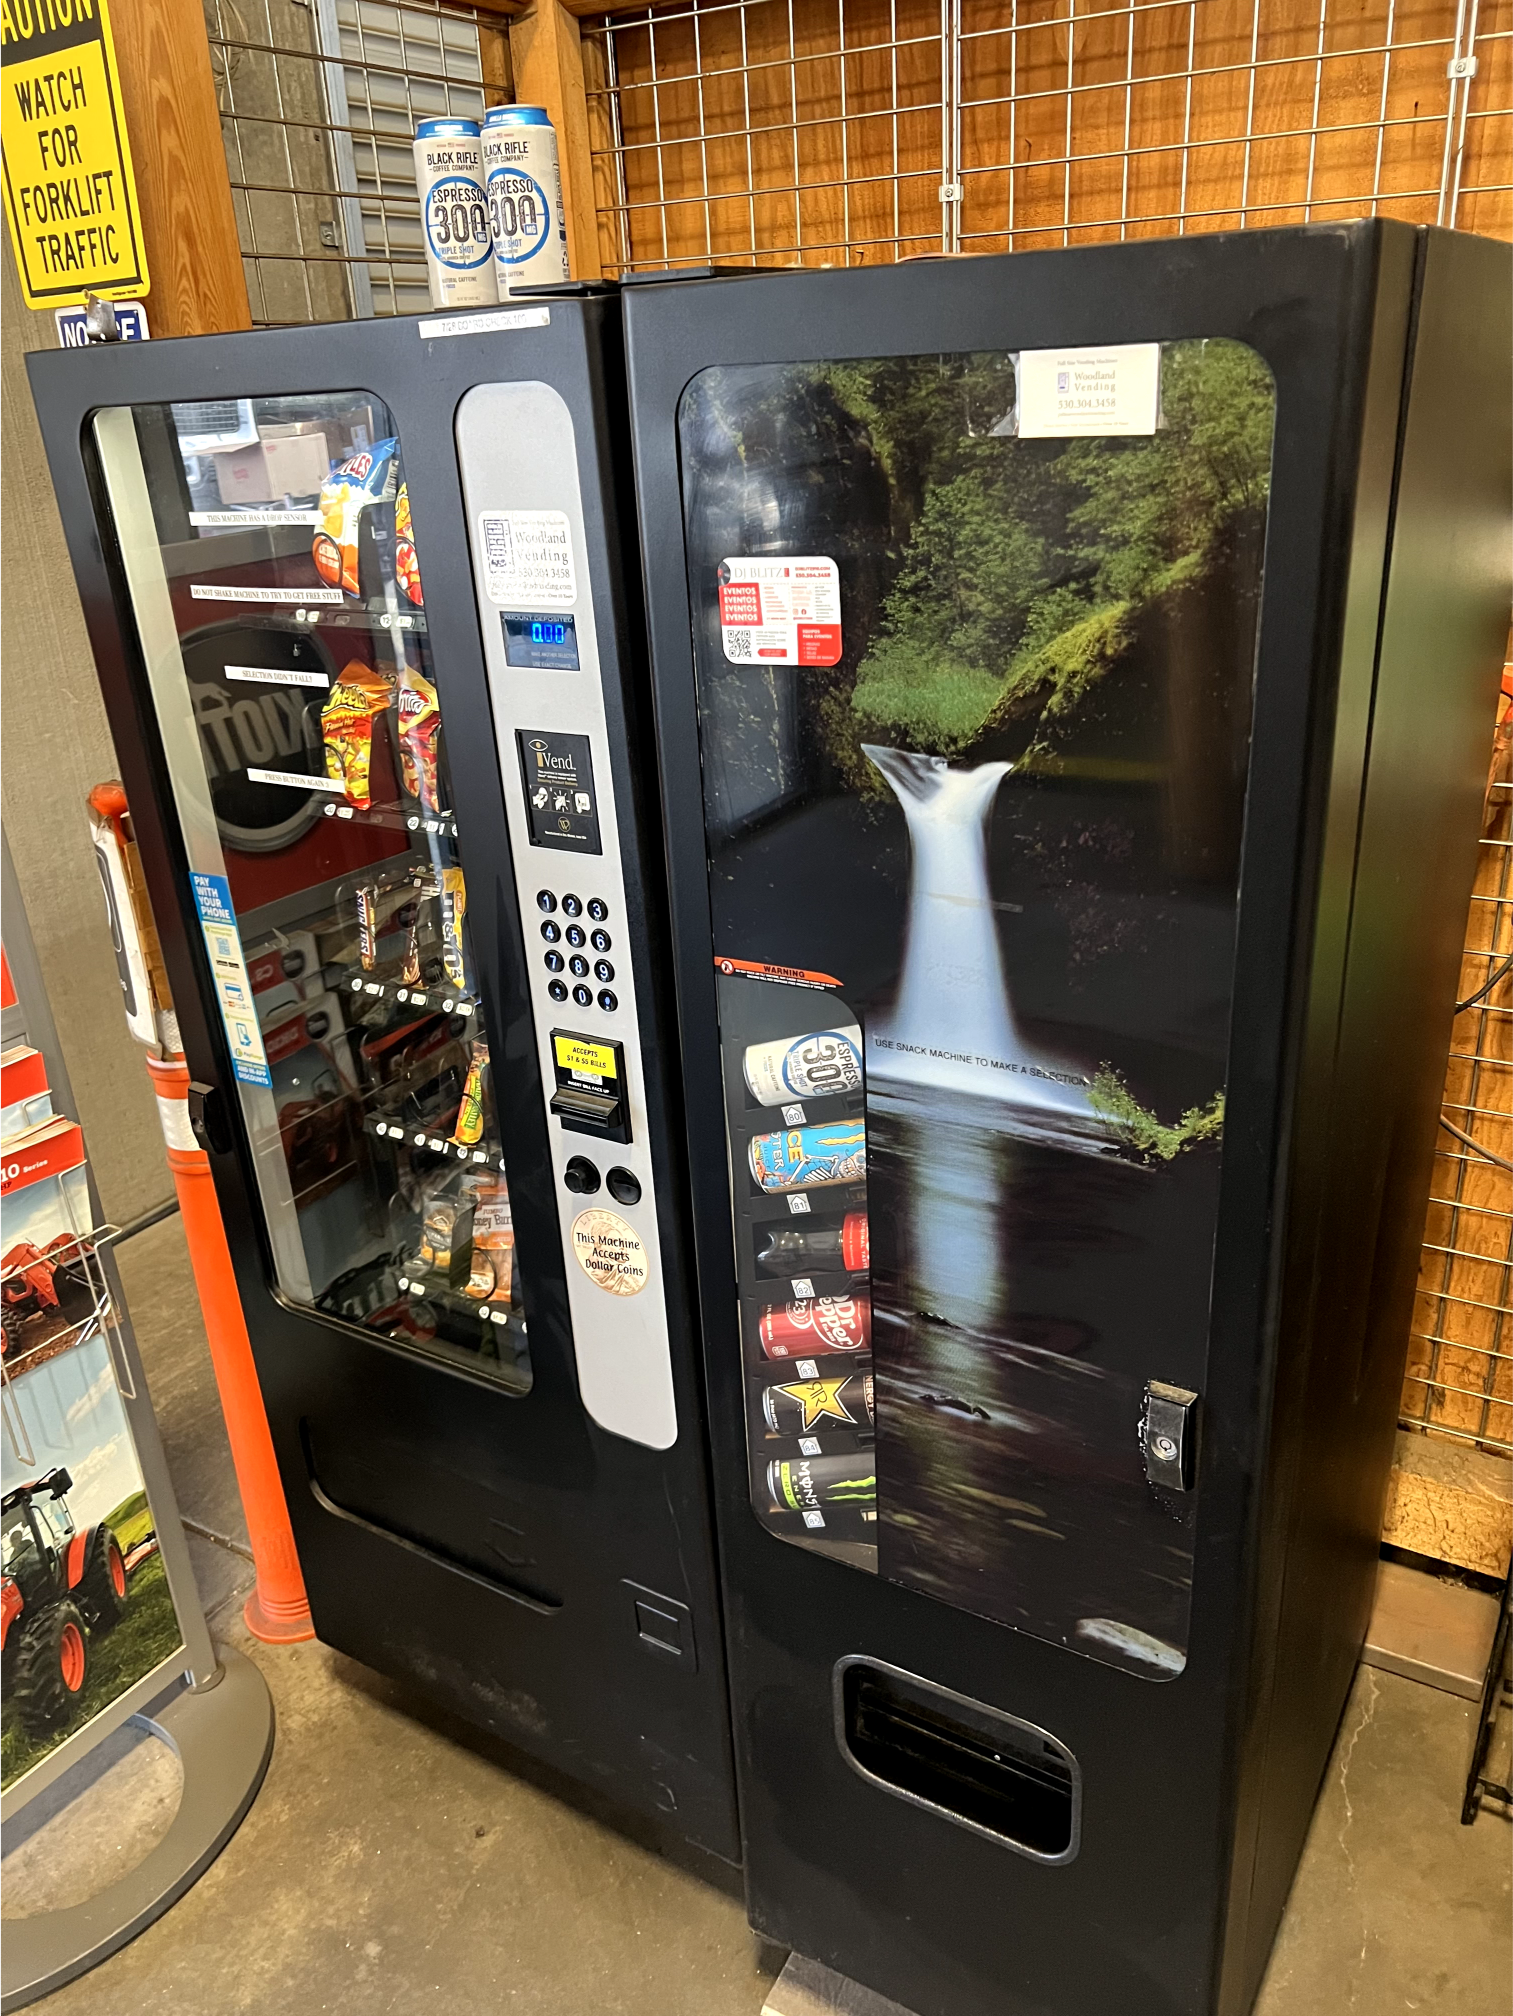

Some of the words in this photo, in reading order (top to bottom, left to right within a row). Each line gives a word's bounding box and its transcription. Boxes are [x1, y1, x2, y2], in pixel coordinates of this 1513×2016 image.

[0, 0, 93, 45] AUTIO
[14, 66, 87, 122] WATCH
[37, 124, 83, 171] FOR
[505, 141, 529, 154] RIFLE
[427, 152, 454, 166] BLACK
[456, 151, 479, 164] RIFLE
[501, 154, 525, 163] COMPANY
[20, 170, 116, 226] FORKLIFT
[432, 187, 484, 204] ESPRESSO
[434, 204, 487, 244] 300
[36, 224, 119, 274] TRAFFIC
[458, 245, 475, 254] SHOT
[62, 317, 137, 348] NOE
[1074, 370, 1116, 381] Woodland
[1074, 383, 1116, 393] Vending
[1058, 398, 1116, 409] 530.304.3458
[207, 514, 220, 523] THIS
[221, 514, 248, 523] MACHINE
[249, 514, 261, 522] HAS
[261, 514, 267, 522] A
[284, 513, 308, 522] SENSOR
[515, 531, 567, 544] Woodland
[516, 548, 569, 566] Vending
[750, 567, 783, 578] BLITZ
[193, 588, 202, 596] DO
[214, 589, 234, 597] SHAKE
[233, 590, 260, 599] MACHINE
[261, 591, 269, 599] TO
[269, 591, 283, 599] TRY
[283, 591, 292, 599] TO
[292, 592, 305, 600] GET
[306, 592, 322, 600] FREE
[322, 592, 341, 600] STUFF
[723, 587, 756, 595] EVENTOS
[724, 596, 757, 604] EVENTOS
[724, 604, 758, 612] EVENTOS
[725, 613, 758, 621] EVENTOS
[242, 670, 273, 680] SELECTION
[273, 672, 294, 681] DIDN'T
[264, 773, 282, 782] PRESS
[282, 775, 306, 785] BUTTON
[307, 779, 325, 787] AGAIN
[193, 875, 210, 887] PAY
[195, 885, 219, 898] WITH
[198, 895, 222, 909] YOUR
[543, 895, 550, 910] 1
[567, 898, 576, 914] 2
[592, 902, 602, 918] 3
[201, 905, 231, 919] PHONE
[546, 925, 554, 940] 4
[571, 930, 579, 945] 5
[596, 934, 605, 949] 6
[549, 954, 557, 969] 7
[574, 959, 583, 974] 8
[599, 964, 609, 979] 9
[763, 965, 805, 978] WARNING
[578, 989, 587, 1004] 0
[572, 1046, 599, 1058] ACCEPTS
[590, 1059, 607, 1069] BILLS
[793, 1051, 802, 1074] TRIPLE
[875, 1038, 894, 1050] USE
[896, 1042, 927, 1056] SNACK
[929, 1048, 973, 1064] MACHINE
[975, 1057, 989, 1067] TO
[990, 1059, 1019, 1073] MAKE
[1020, 1066, 1027, 1075] A
[1029, 1067, 1088, 1087] SELECTION
[238, 1071, 269, 1085] DISCOUNTS
[788, 1111, 800, 1122] 80
[23, 1160, 48, 1173] Series
[793, 1202, 805, 1211] 81
[576, 1232, 595, 1244] This
[598, 1235, 641, 1250] Machine
[592, 1247, 630, 1262] Accepts
[585, 1258, 615, 1272] Dollar
[617, 1263, 644, 1277] Coins
[798, 1286, 809, 1295] 82
[793, 1299, 808, 1314] 23
[833, 1299, 856, 1329] Dr
[815, 1297, 854, 1347] epper
[864, 1375, 874, 1409] NERGY
